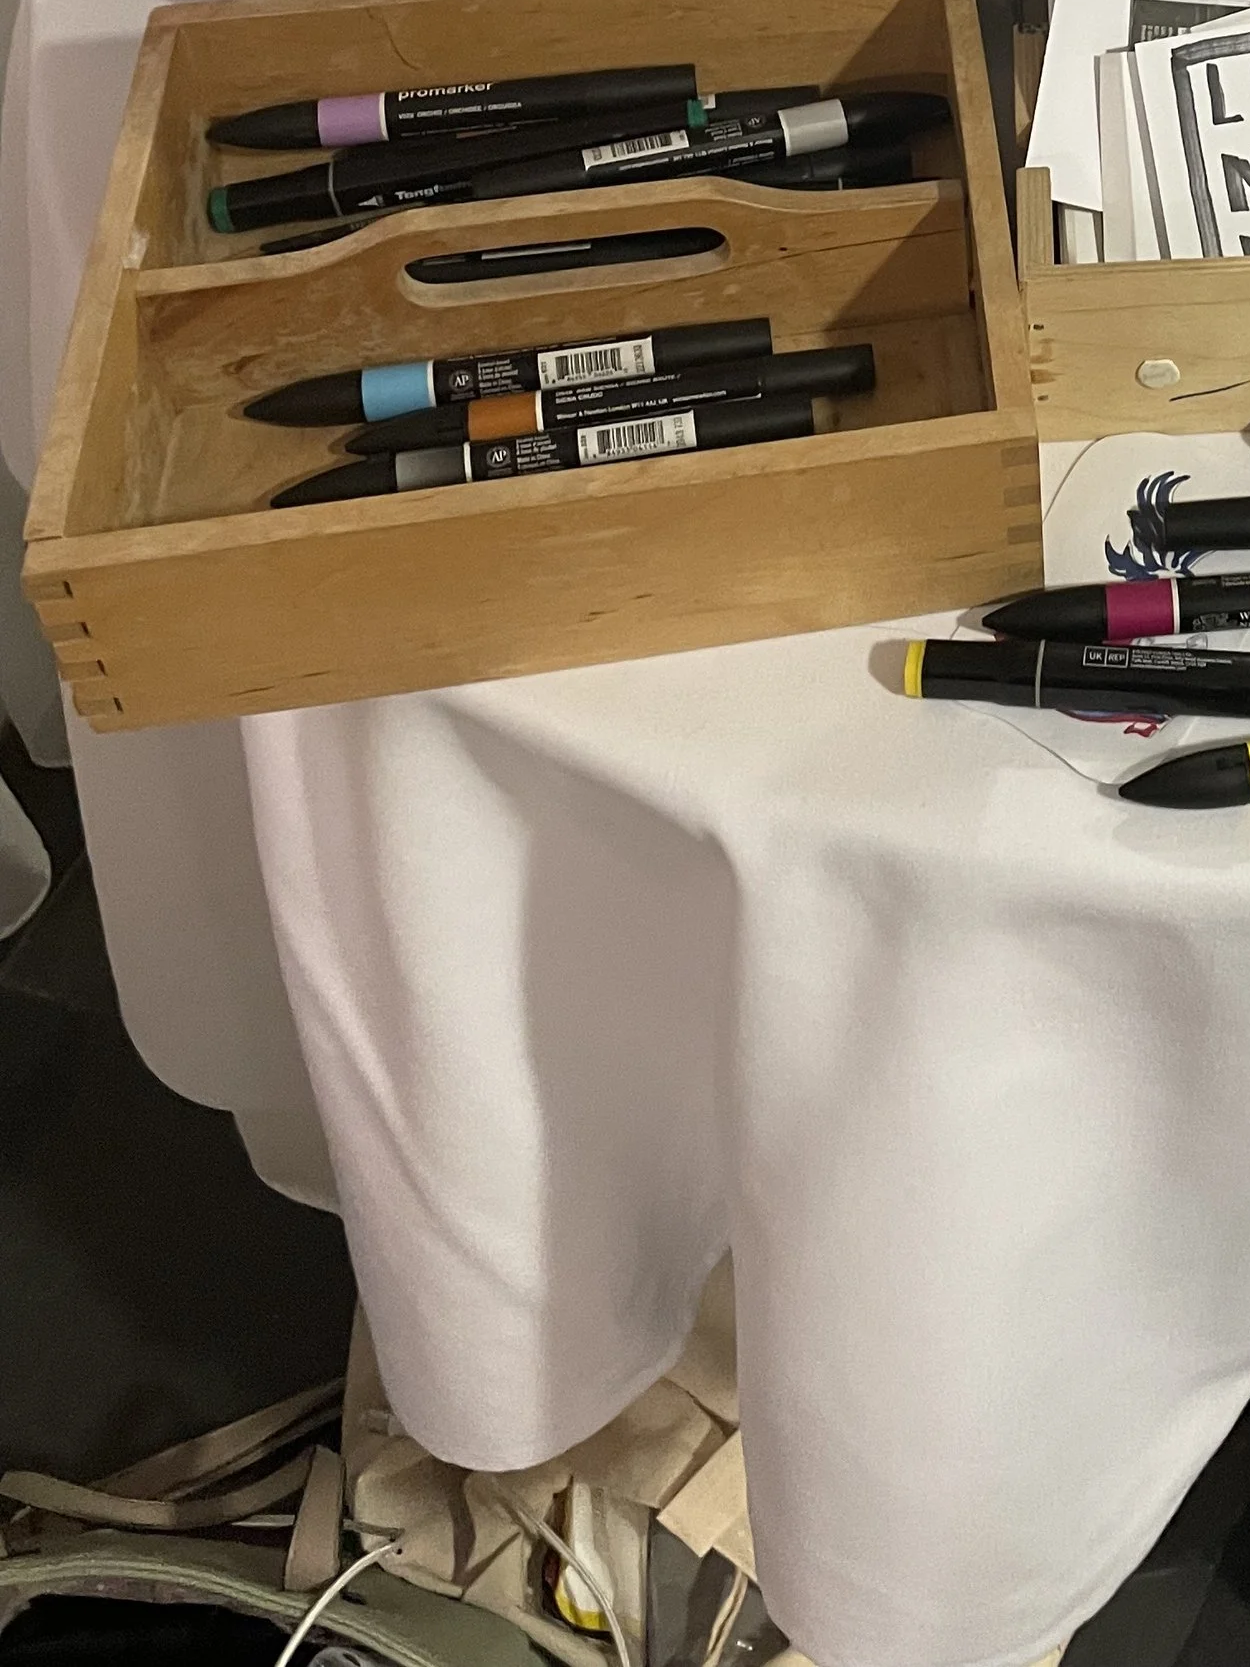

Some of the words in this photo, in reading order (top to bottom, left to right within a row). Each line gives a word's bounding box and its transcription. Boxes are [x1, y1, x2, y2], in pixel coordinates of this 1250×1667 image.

[398, 82, 494, 102] promarker
[1088, 652, 1102, 662] UK
[1108, 653, 1126, 662] REP
